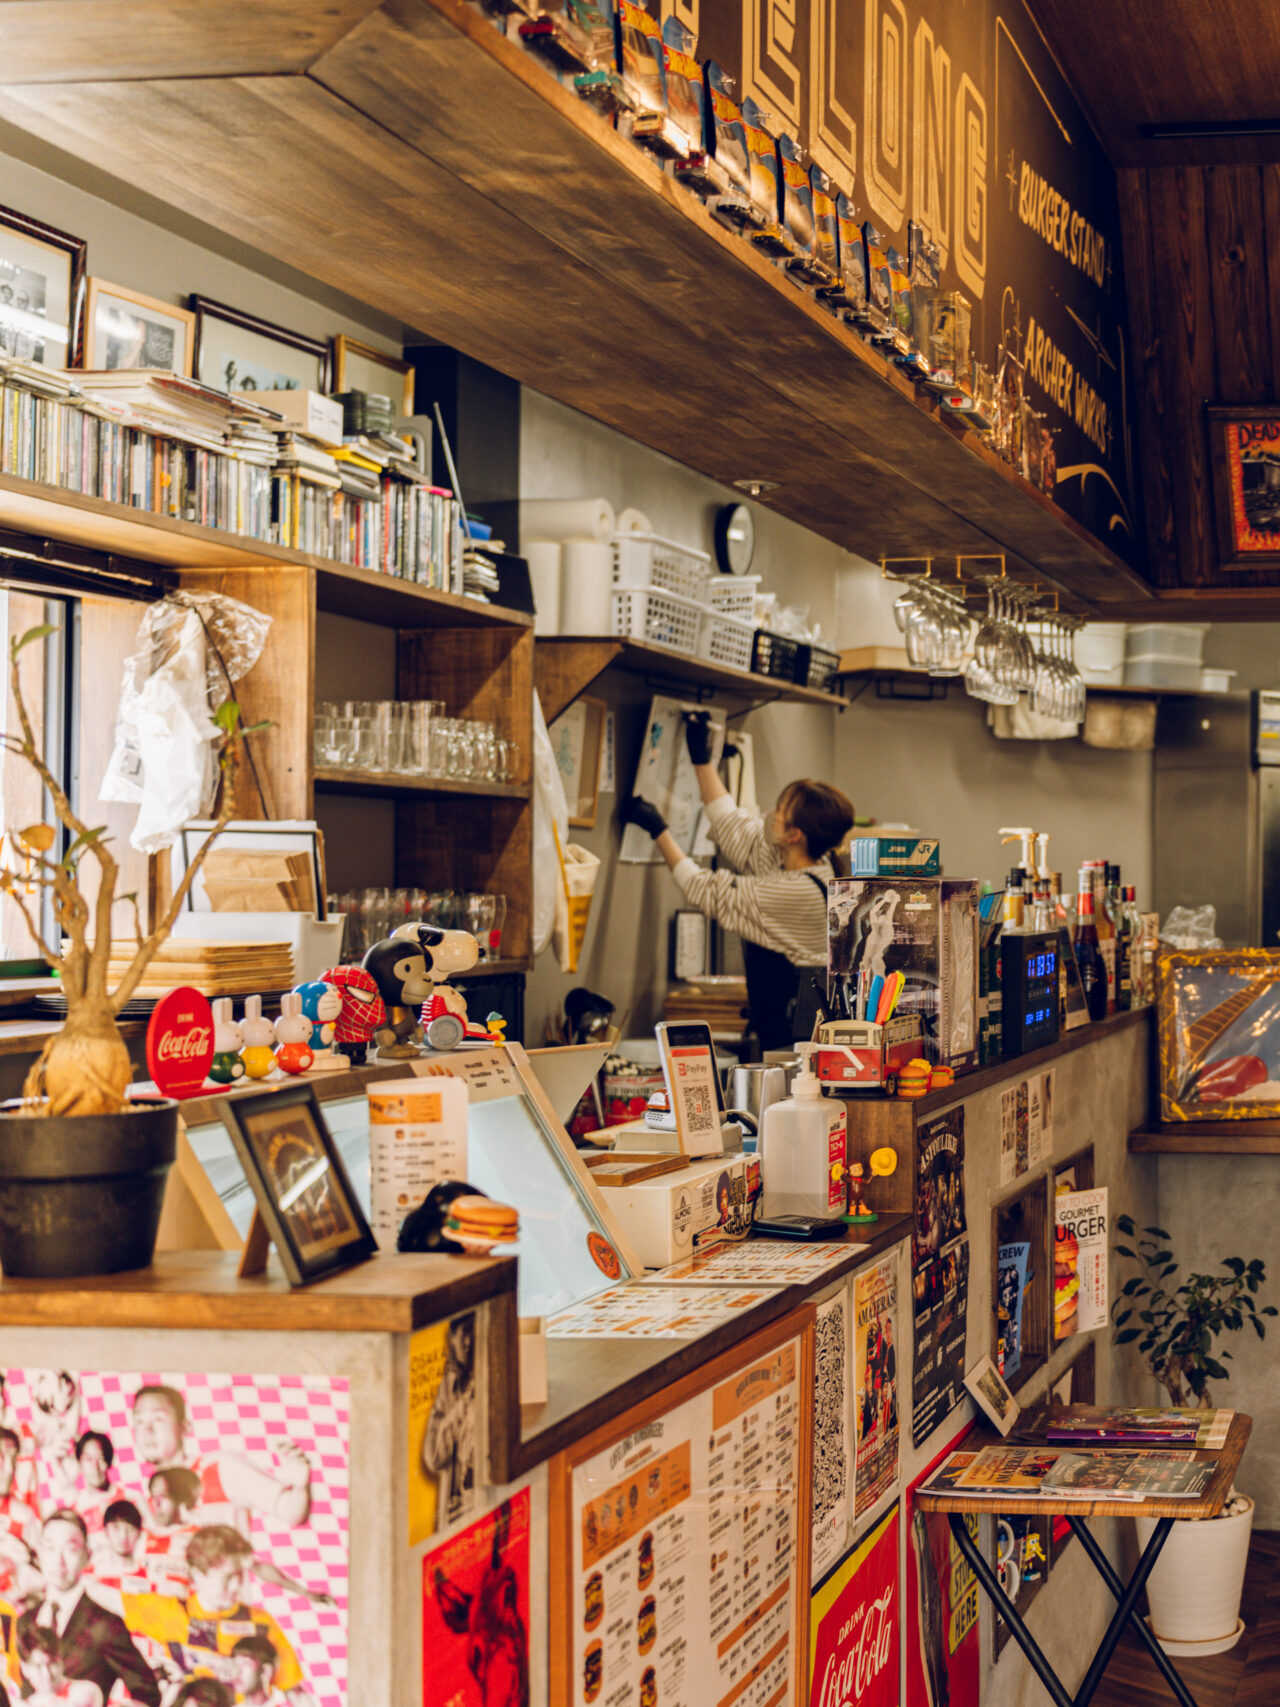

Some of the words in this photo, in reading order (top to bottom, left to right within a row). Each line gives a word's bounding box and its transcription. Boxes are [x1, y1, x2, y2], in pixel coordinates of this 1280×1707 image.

[660, 0, 988, 300] ELONG
[1019, 161, 1071, 258] BURGER
[1070, 210, 1105, 289] STAND
[1024, 316, 1073, 417] ARCHER
[1075, 373, 1107, 454] WORKS
[1240, 423, 1280, 450] DEAD
[918, 843, 932, 855] JR
[1059, 1204, 1100, 1221] GOURMET
[837, 1600, 866, 1646] DRINK
[954, 1586, 978, 1642] HERE
